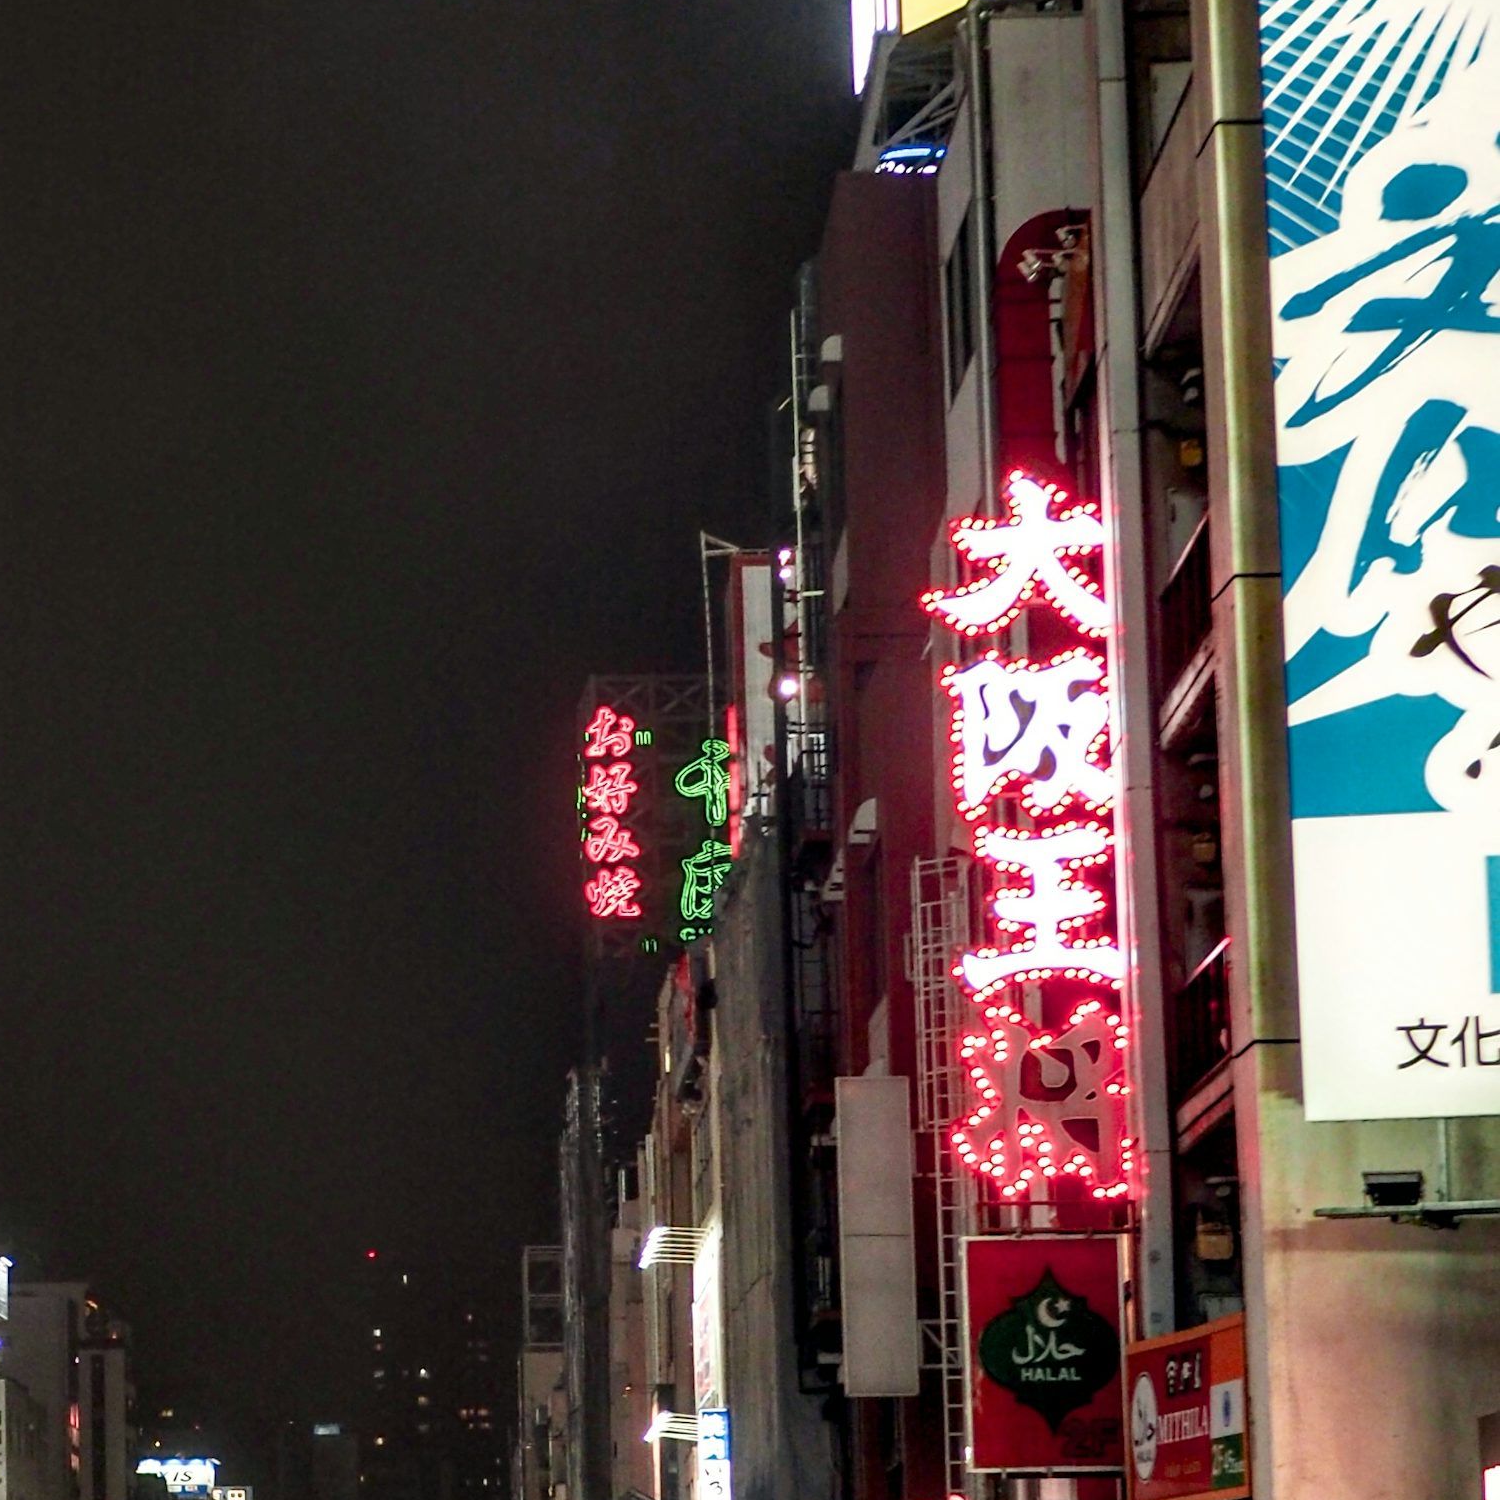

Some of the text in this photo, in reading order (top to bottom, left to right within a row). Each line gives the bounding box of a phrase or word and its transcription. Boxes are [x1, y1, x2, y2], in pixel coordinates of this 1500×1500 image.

[920, 469, 1136, 1198] 大阪王将
[1395, 1015, 1500, 1070] 文化
[1011, 1322, 1086, 1365] حلال
[1020, 1367, 1082, 1382] HALAL
[1156, 1404, 1210, 1446] MITHILA
